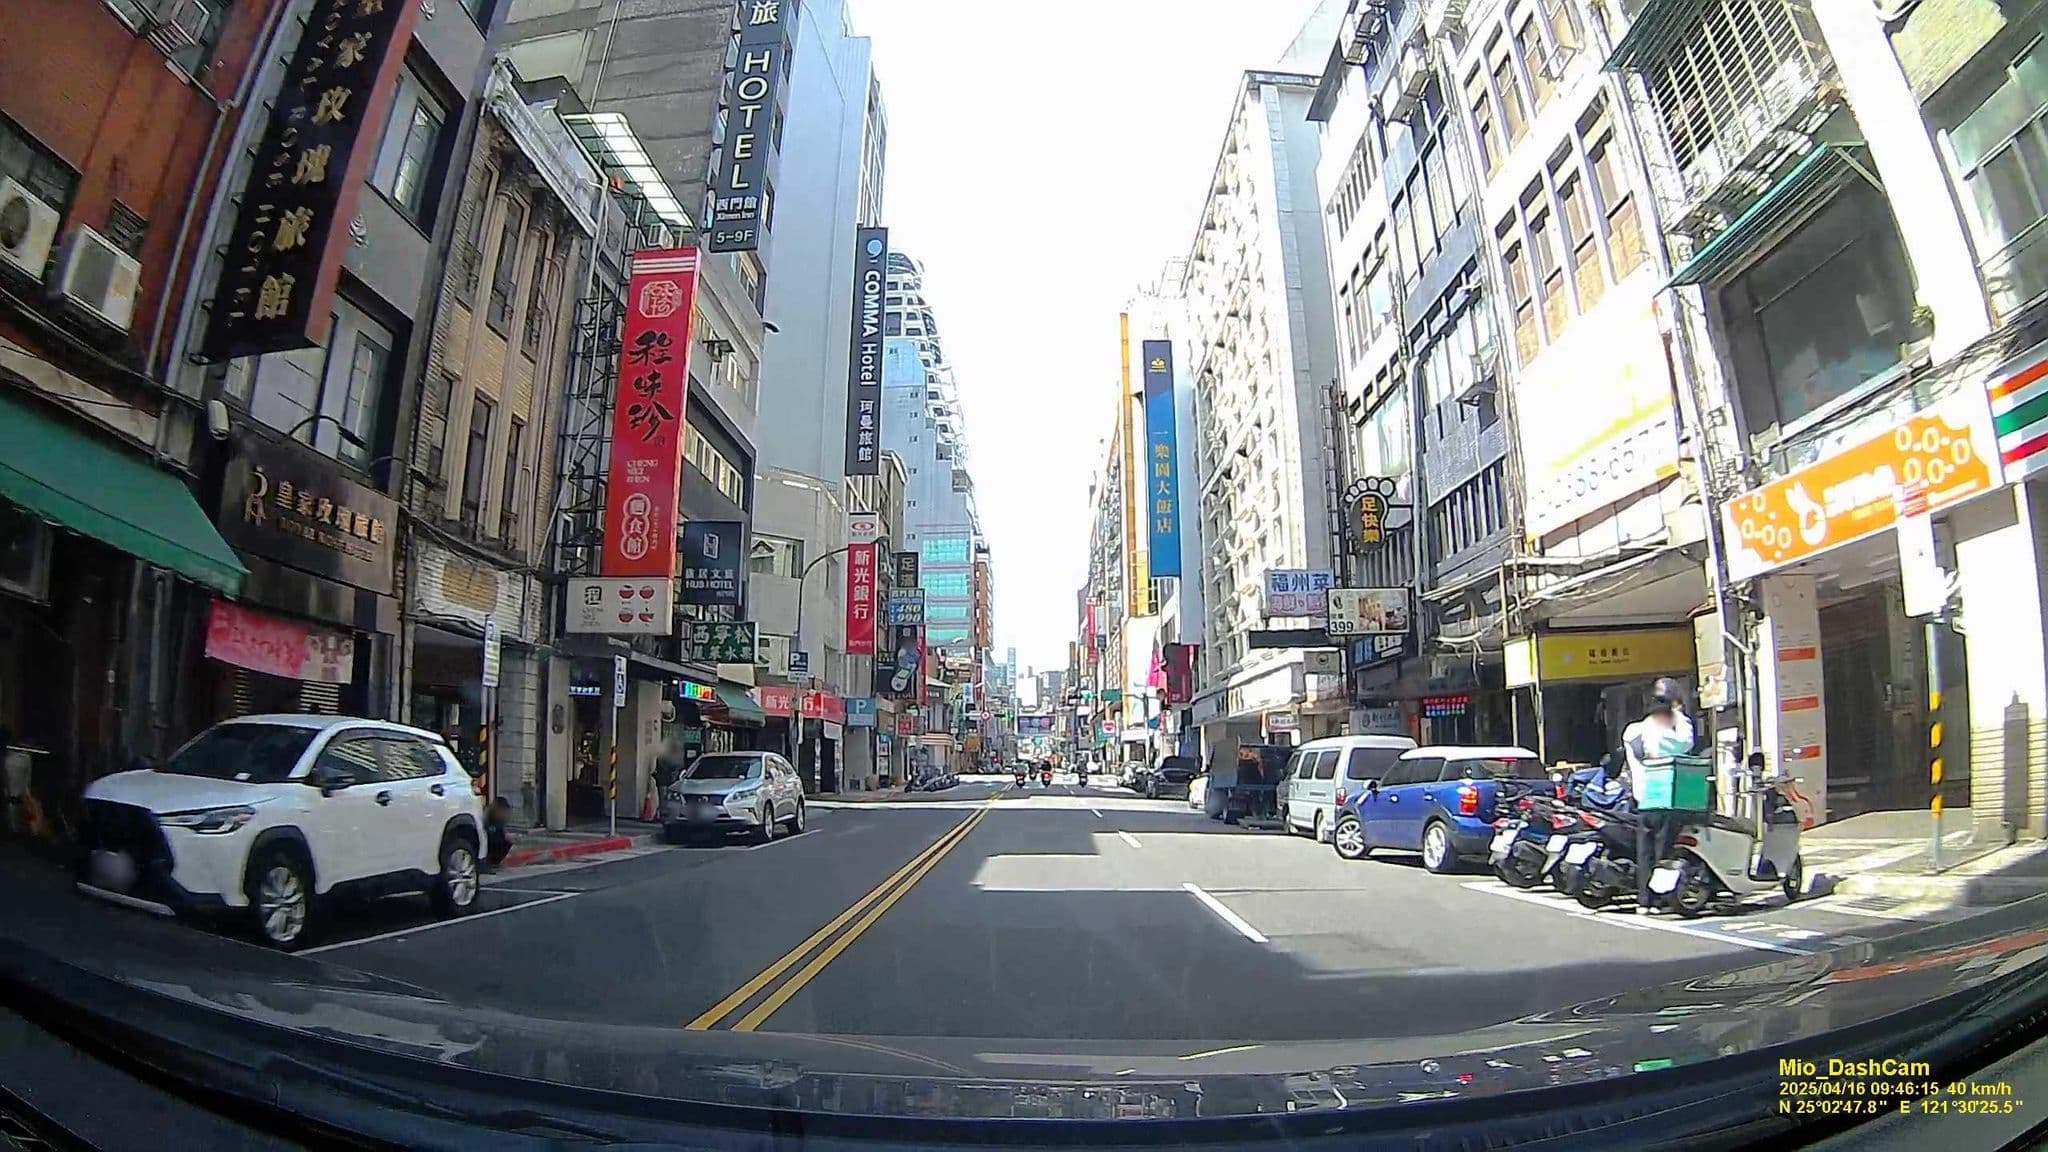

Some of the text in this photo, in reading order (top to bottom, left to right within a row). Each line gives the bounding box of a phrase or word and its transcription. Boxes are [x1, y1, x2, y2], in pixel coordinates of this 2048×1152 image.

[731, 50, 770, 189] HOTEL
[716, 196, 757, 211] 西門館
[860, 271, 880, 386] COMMA Hotel
[628, 331, 674, 442] 程味珍
[706, 581, 734, 589] HOTEL
[854, 550, 870, 620] 新光銀行
[1271, 573, 1329, 592] 福州菜
[1331, 621, 1354, 632] 399
[791, 653, 800, 666] P
[856, 700, 866, 714] P
